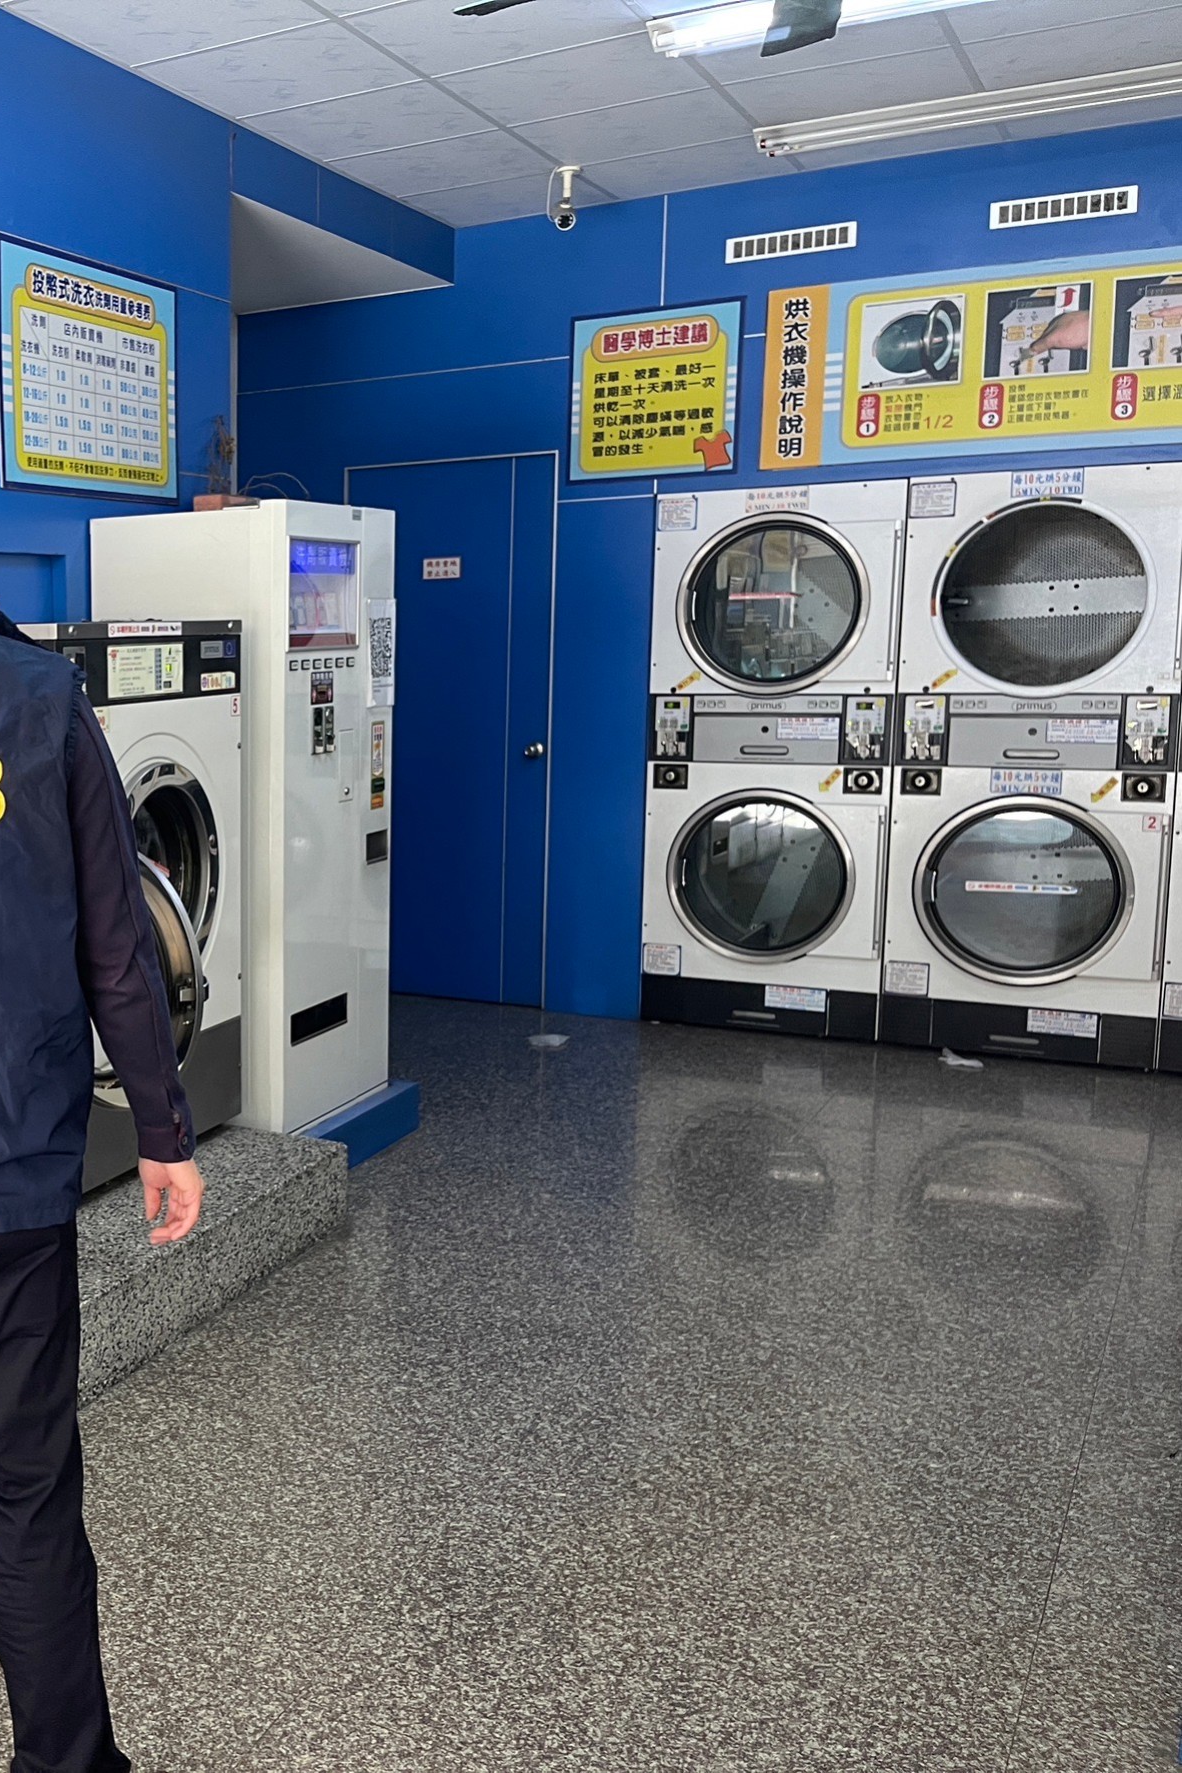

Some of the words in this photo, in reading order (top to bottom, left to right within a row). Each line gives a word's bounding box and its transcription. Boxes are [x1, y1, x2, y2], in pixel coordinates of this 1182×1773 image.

[32, 268, 152, 323] 投幣式洗衣洗劑用量參考表
[603, 322, 708, 354] 醫學博士建議
[594, 363, 716, 384] 床單、被套、最好一
[778, 297, 811, 459] 烘衣機操作說明
[593, 377, 715, 399] 星期至十天清洗一次
[1116, 375, 1132, 402] 步驟
[983, 386, 999, 411] 步驟
[593, 399, 656, 414] 烘乾一次。
[1121, 405, 1128, 415] 3
[593, 407, 715, 428] 可以清除塵蟎等過敏
[924, 415, 954, 430] 1/2
[988, 414, 995, 424] 2
[592, 422, 714, 443] 源，以減少氣喘，感
[592, 443, 654, 458] 冒的發生。
[1014, 471, 1082, 485] 每10元烘5分鐘
[232, 698, 238, 714] 5
[749, 701, 783, 712] primus
[1015, 701, 1054, 711] primus
[993, 771, 1060, 784] 每10元烘5分鐘
[1149, 816, 1157, 829] 2
